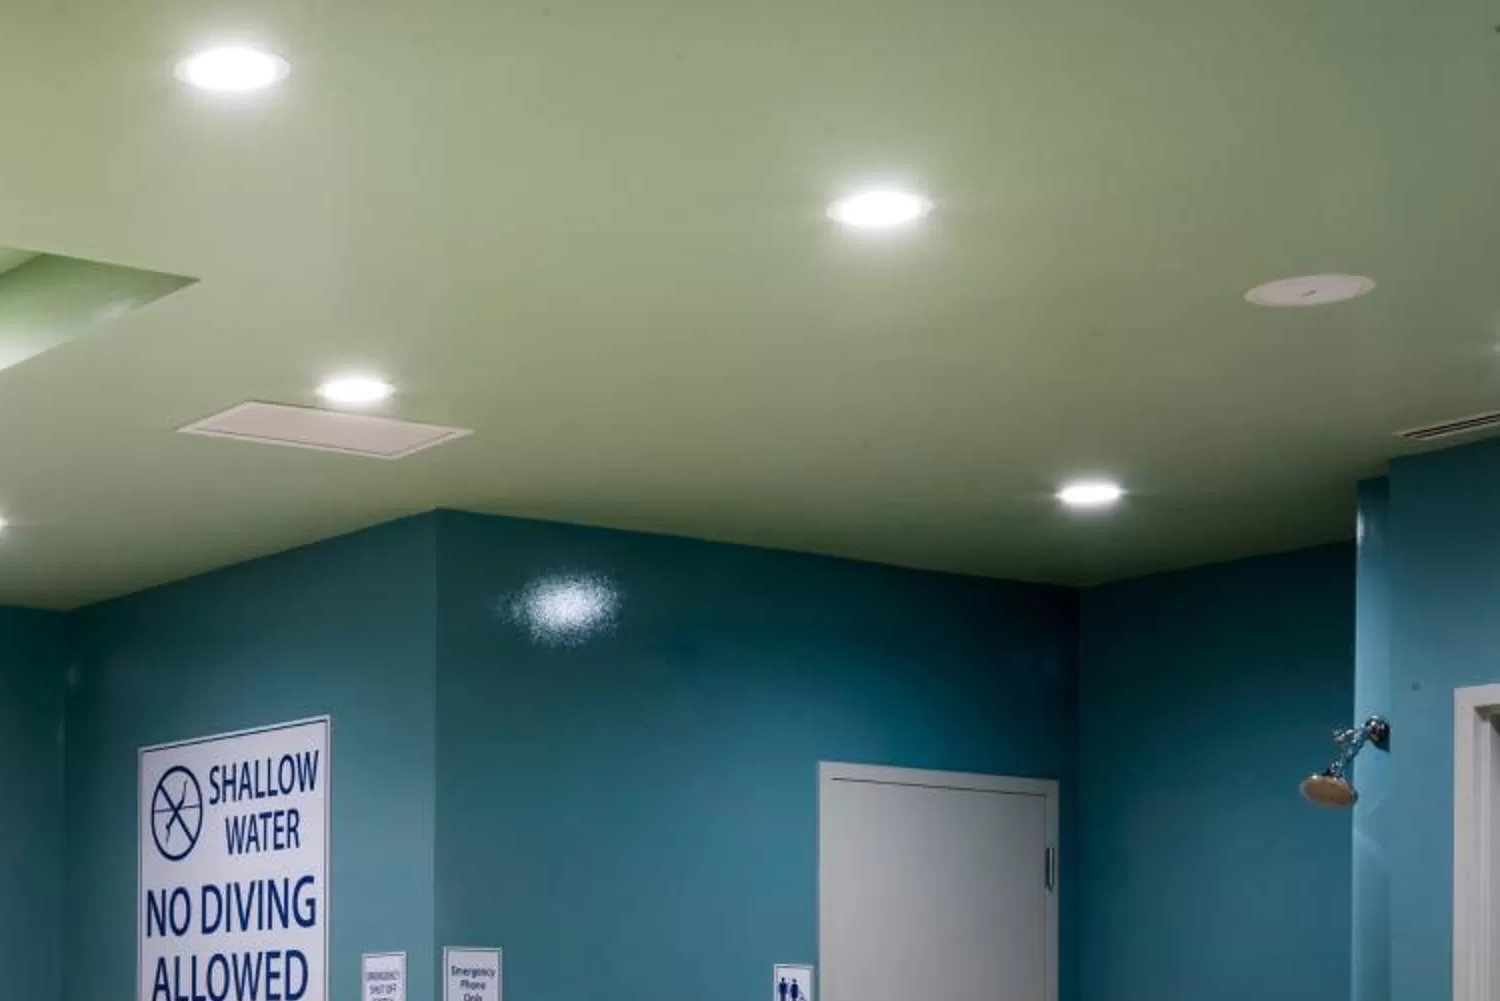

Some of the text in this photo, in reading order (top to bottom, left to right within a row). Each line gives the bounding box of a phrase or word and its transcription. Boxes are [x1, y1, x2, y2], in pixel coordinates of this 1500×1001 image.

[209, 749, 319, 805] SHALLOW
[225, 808, 300, 855] WATER
[147, 875, 316, 938] NO DIVING
[451, 965, 496, 979] Emergency
